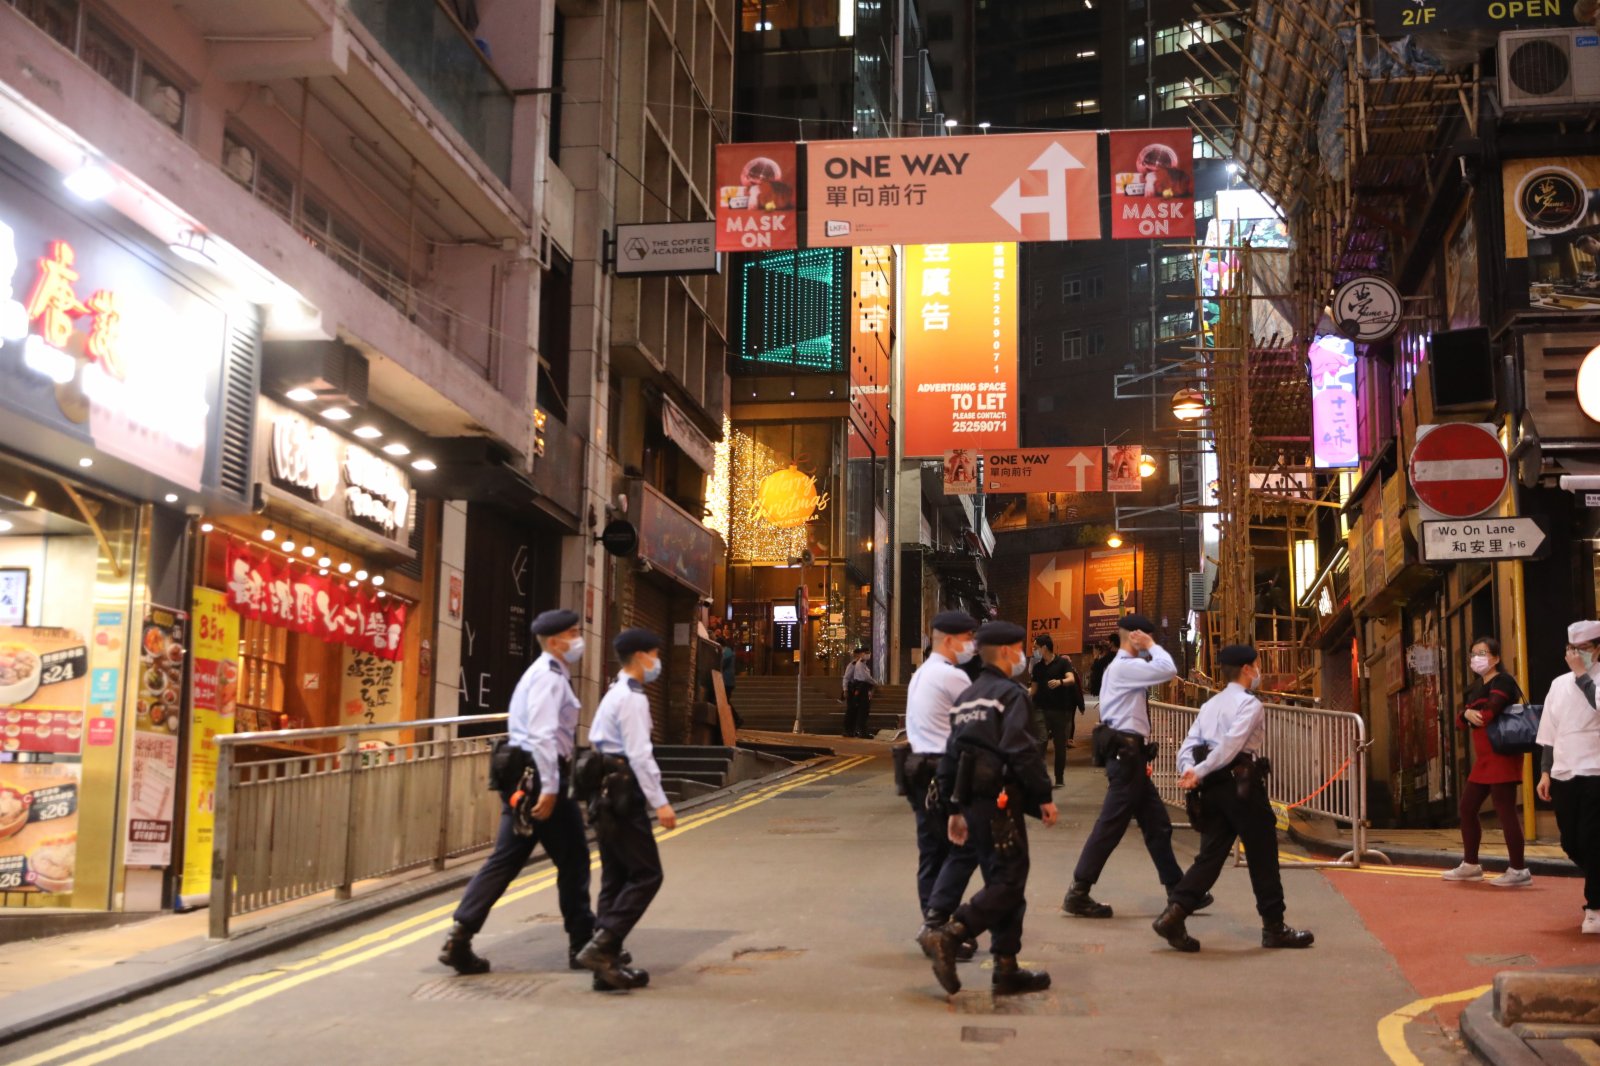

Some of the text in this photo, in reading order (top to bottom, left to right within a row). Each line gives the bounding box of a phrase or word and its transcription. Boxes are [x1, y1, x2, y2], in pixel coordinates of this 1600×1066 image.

[1402, 8, 1436, 25] 2/F
[1488, 0, 1560, 19] OPEN
[824, 151, 970, 179] ONE WAY
[826, 184, 927, 207] 單向前行
[1122, 202, 1184, 219] MASK
[726, 215, 786, 232] MASK
[1138, 219, 1169, 236] ON
[671, 238, 710, 246] COFFEE
[741, 232, 771, 248] ON
[918, 382, 1006, 393] ADVERTISING SPACE
[951, 393, 1007, 410] TO LET
[952, 412, 975, 420] PLEASE
[1323, 396, 1351, 448] 十二味
[952, 421, 1007, 433] 25259071
[990, 454, 1050, 465] ONE WAY
[990, 467, 1032, 477] 單向前行
[1438, 524, 1515, 536] Wo On Lane
[1452, 539, 1526, 554] 和安里 1-16
[1031, 617, 1060, 630] EXIT
[43, 662, 74, 684] $24
[40, 801, 69, 821] $26
